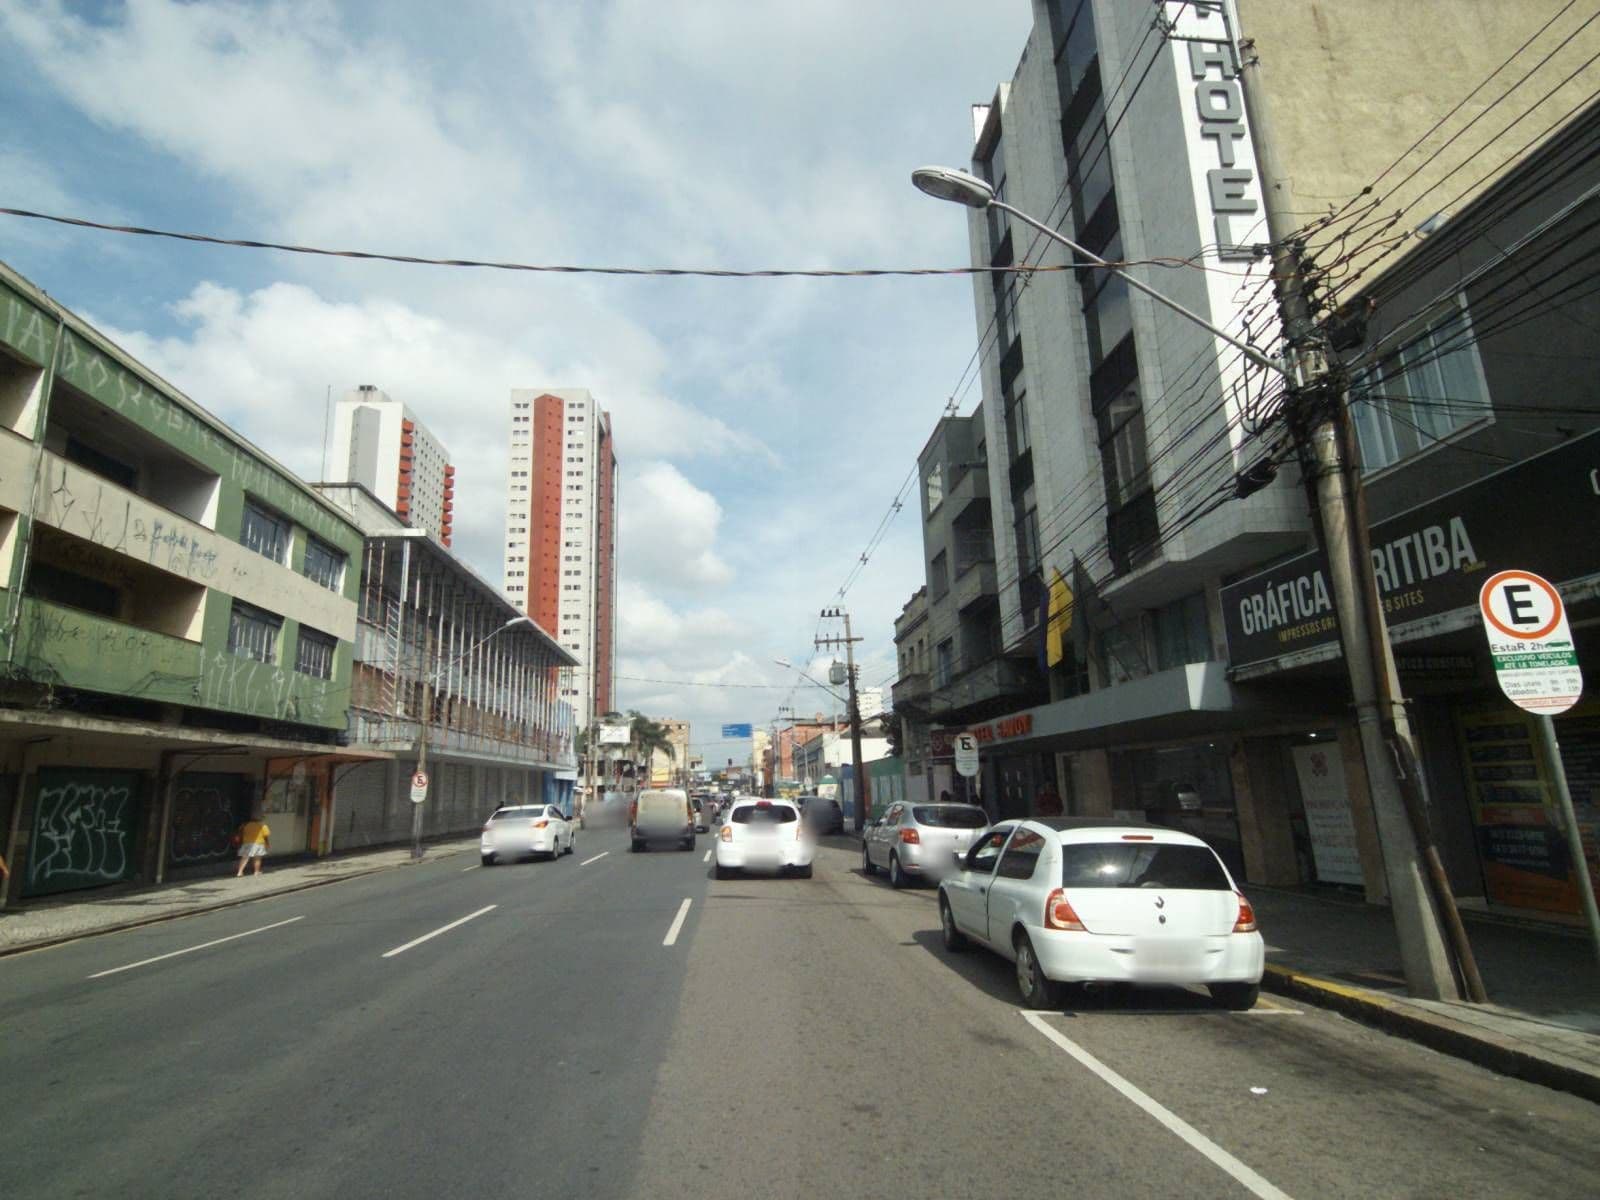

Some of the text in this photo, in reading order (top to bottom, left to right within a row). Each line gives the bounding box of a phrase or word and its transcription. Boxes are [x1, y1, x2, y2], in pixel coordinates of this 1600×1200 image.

[1187, 40, 1264, 261] HOTEL
[1239, 516, 1478, 636] GRÁFICA RITIBA
[1394, 589, 1425, 611] SITES
[1503, 584, 1540, 625] E
[1491, 641, 1544, 653] EstaR 2h
